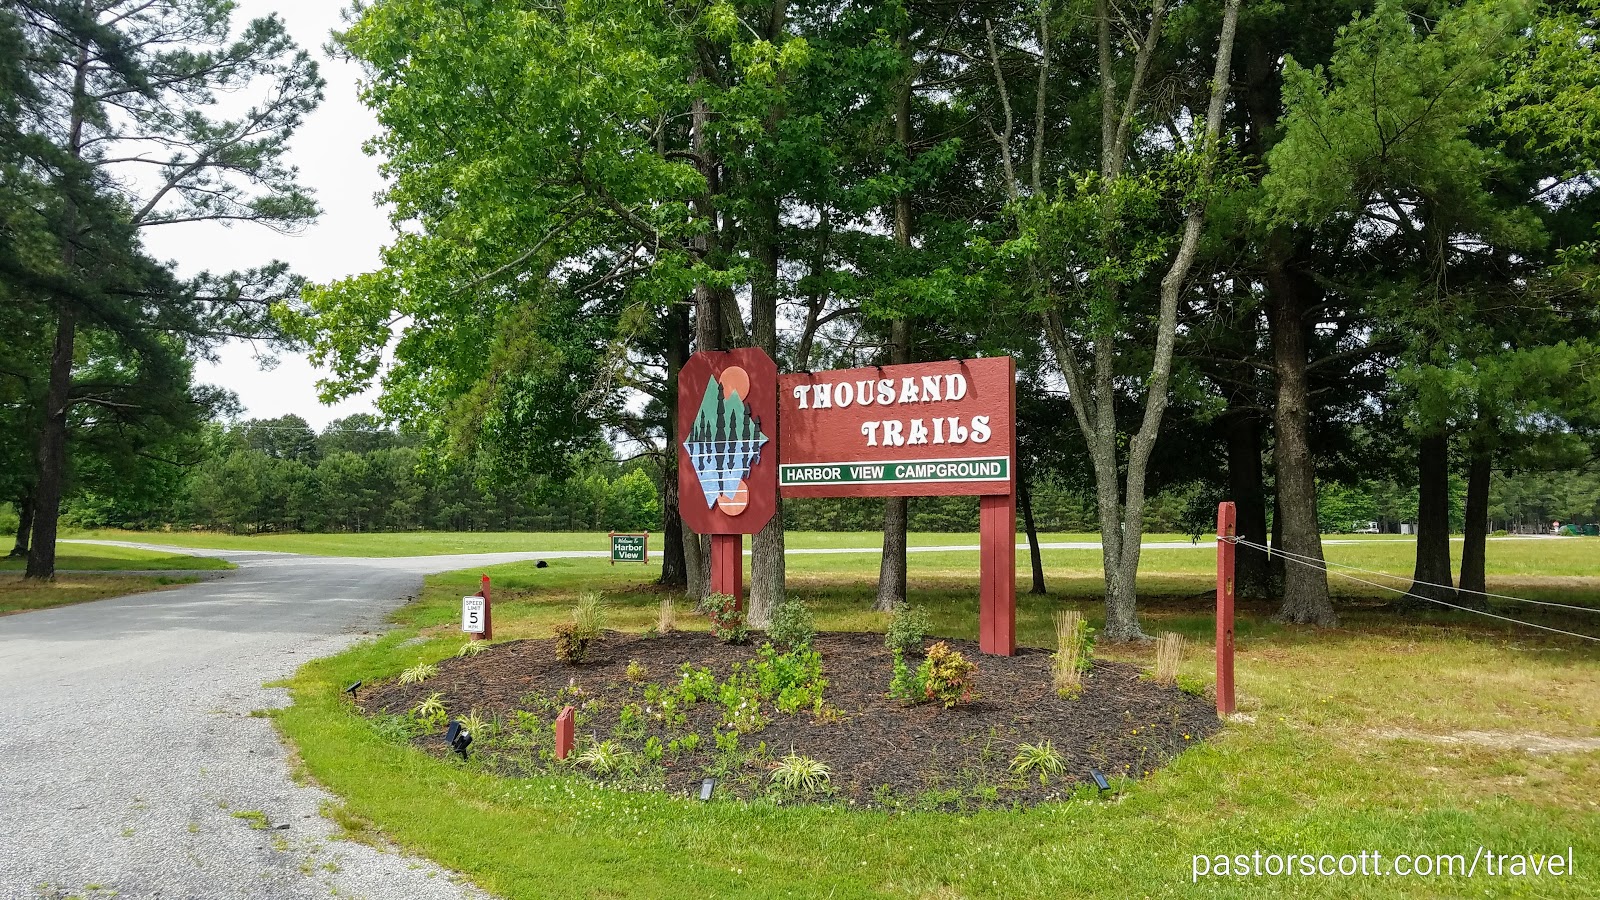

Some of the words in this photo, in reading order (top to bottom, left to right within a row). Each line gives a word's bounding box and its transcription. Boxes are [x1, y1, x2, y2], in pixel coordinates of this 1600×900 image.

[794, 373, 967, 410] THOUSAND
[861, 415, 992, 448] TRAILS
[786, 467, 841, 481] HARBOR
[849, 465, 885, 479] VIEW
[894, 462, 1002, 479] CAMPGROUND
[614, 543, 643, 551] Harbor
[618, 551, 639, 559] View
[469, 612, 479, 624] 5
